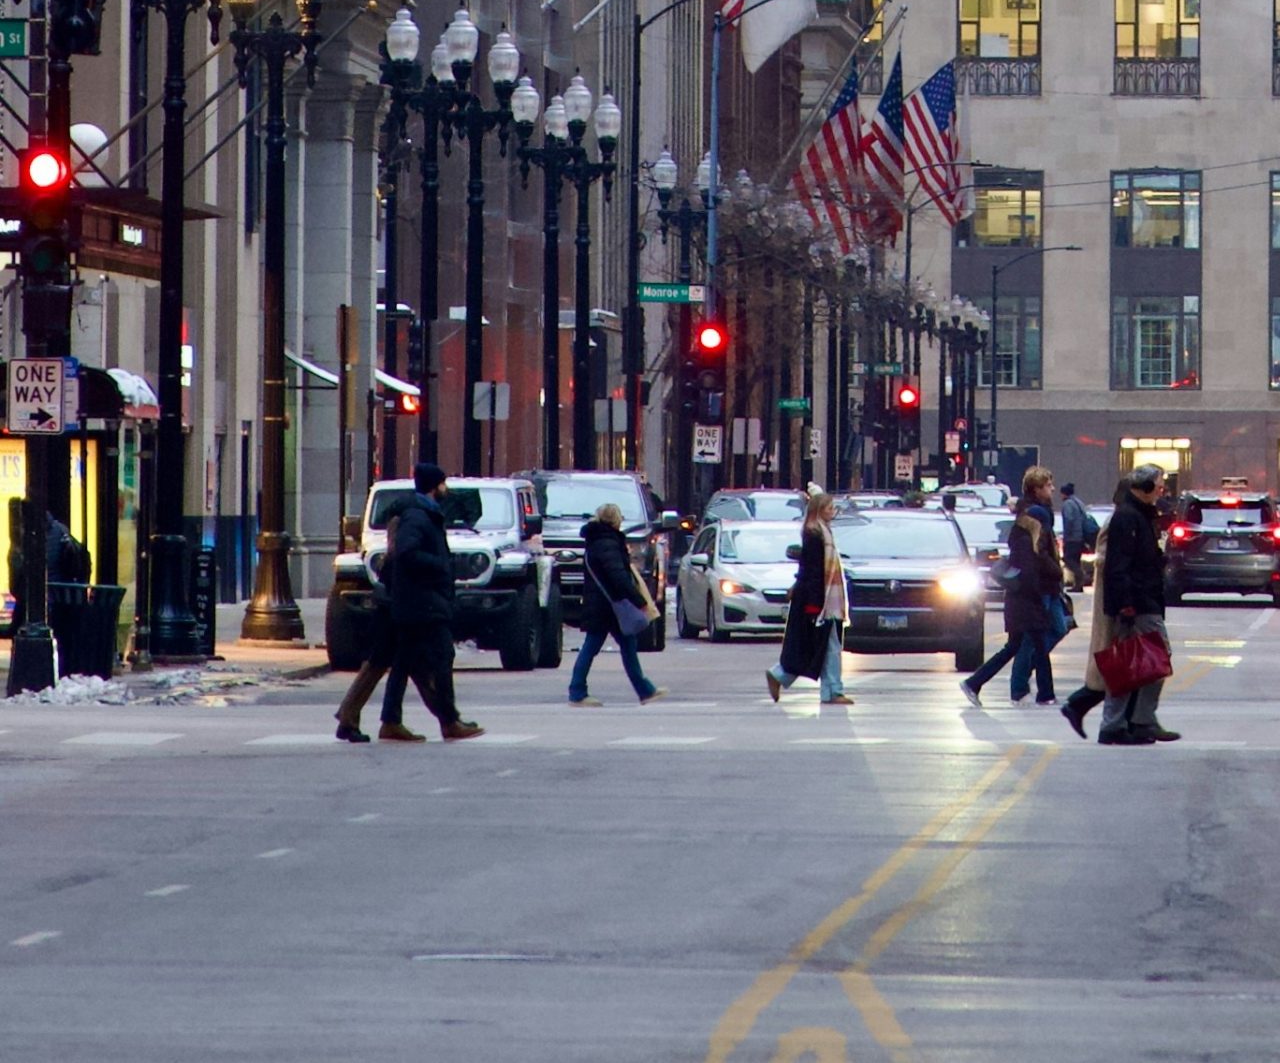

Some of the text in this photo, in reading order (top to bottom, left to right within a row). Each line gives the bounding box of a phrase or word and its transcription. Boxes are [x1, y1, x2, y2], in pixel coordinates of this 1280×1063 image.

[9, 32, 20, 44] St
[643, 286, 679, 298] Monroe
[16, 365, 57, 383] ONE
[15, 386, 57, 404] WAY
[697, 428, 718, 438] ONE
[696, 438, 718, 448] WAY
